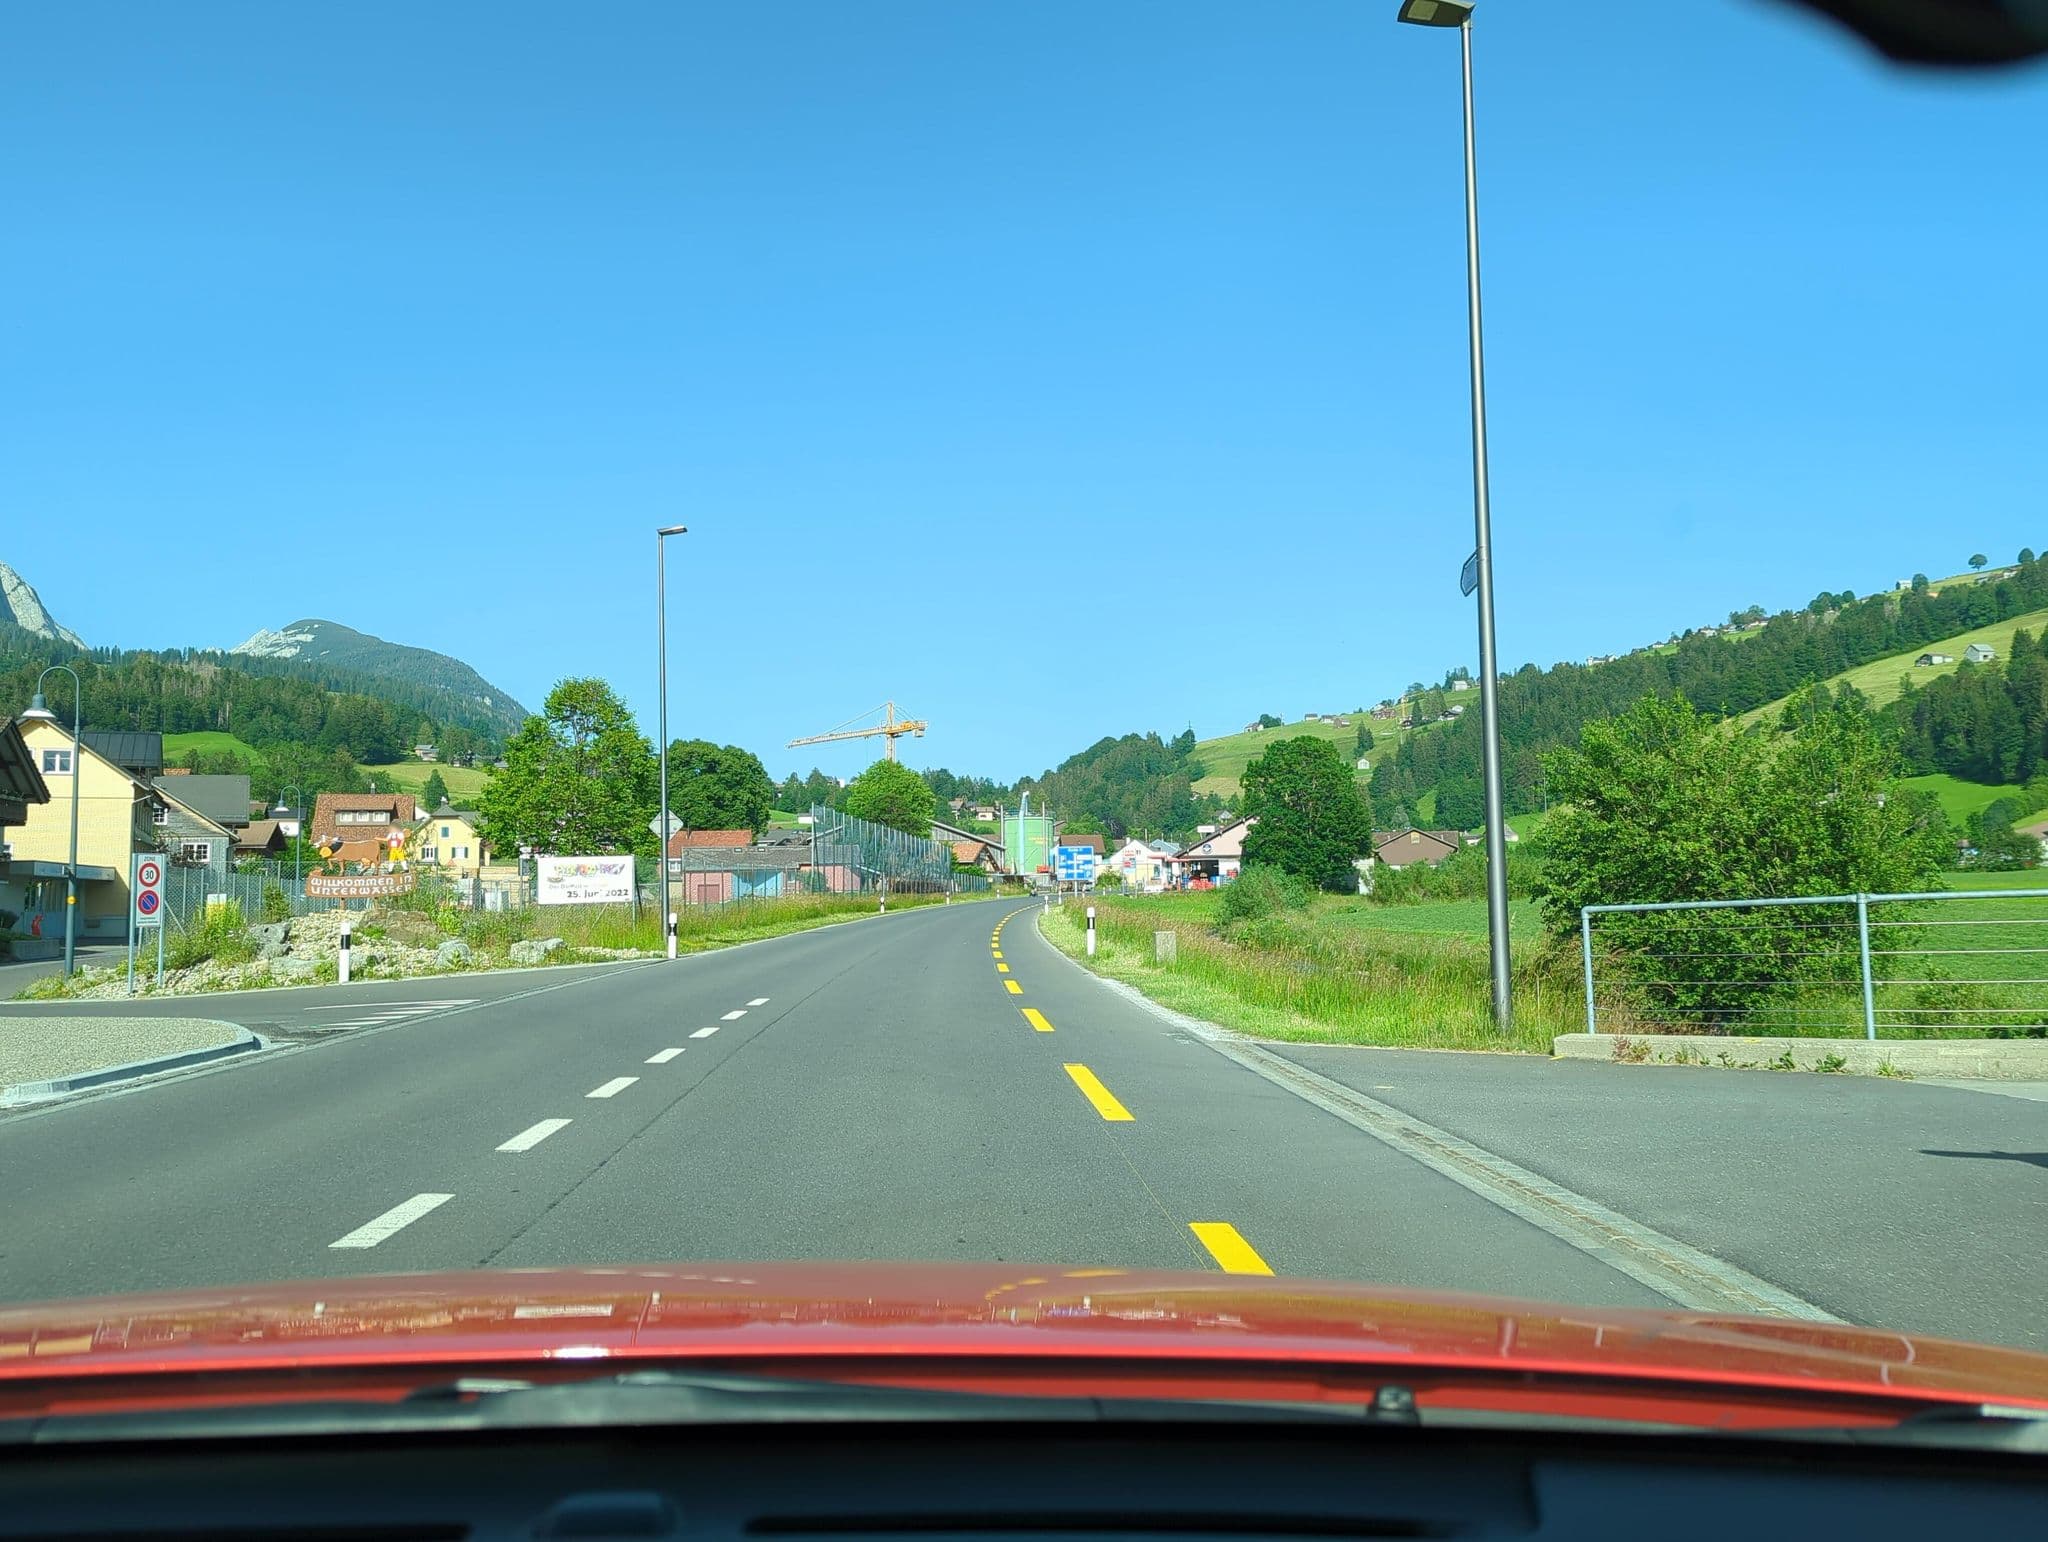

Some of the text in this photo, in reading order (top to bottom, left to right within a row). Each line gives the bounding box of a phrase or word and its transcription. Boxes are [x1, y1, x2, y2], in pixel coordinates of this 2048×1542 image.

[145, 870, 154, 880] 30
[311, 875, 412, 887] WILLKOMMEN IN
[311, 884, 412, 895] UNTERWASSER
[567, 890, 581, 898] 25.
[606, 889, 629, 897] 2022
